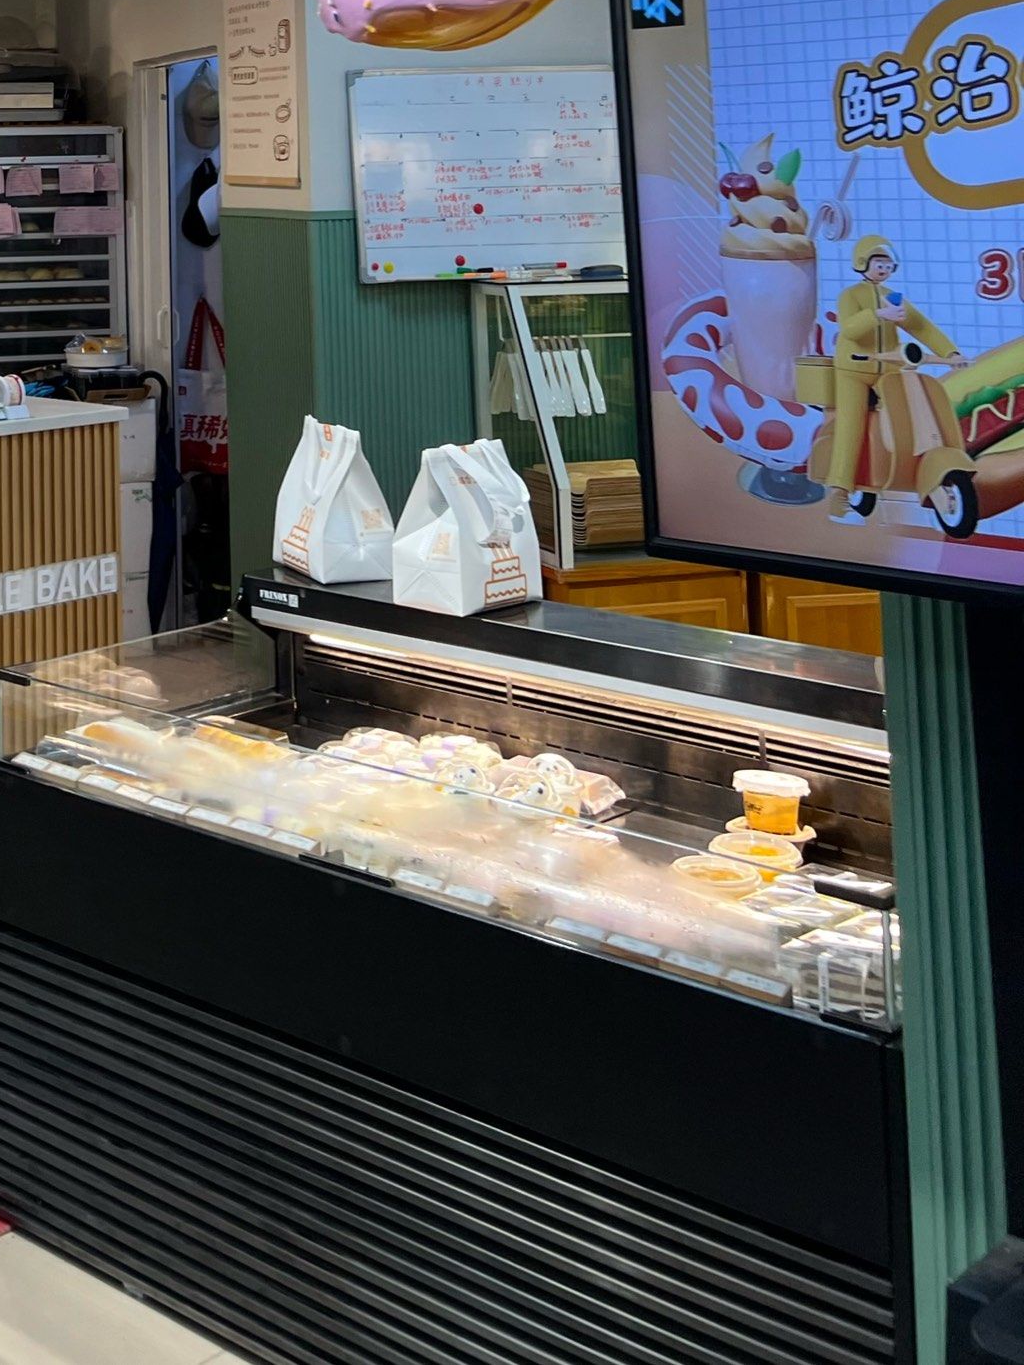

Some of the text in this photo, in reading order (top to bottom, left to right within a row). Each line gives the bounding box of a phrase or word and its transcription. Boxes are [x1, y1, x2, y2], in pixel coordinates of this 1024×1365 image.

[841, 42, 1010, 143] 鲸治
[976, 248, 1024, 301] 3
[37, 556, 116, 604] BAKE
